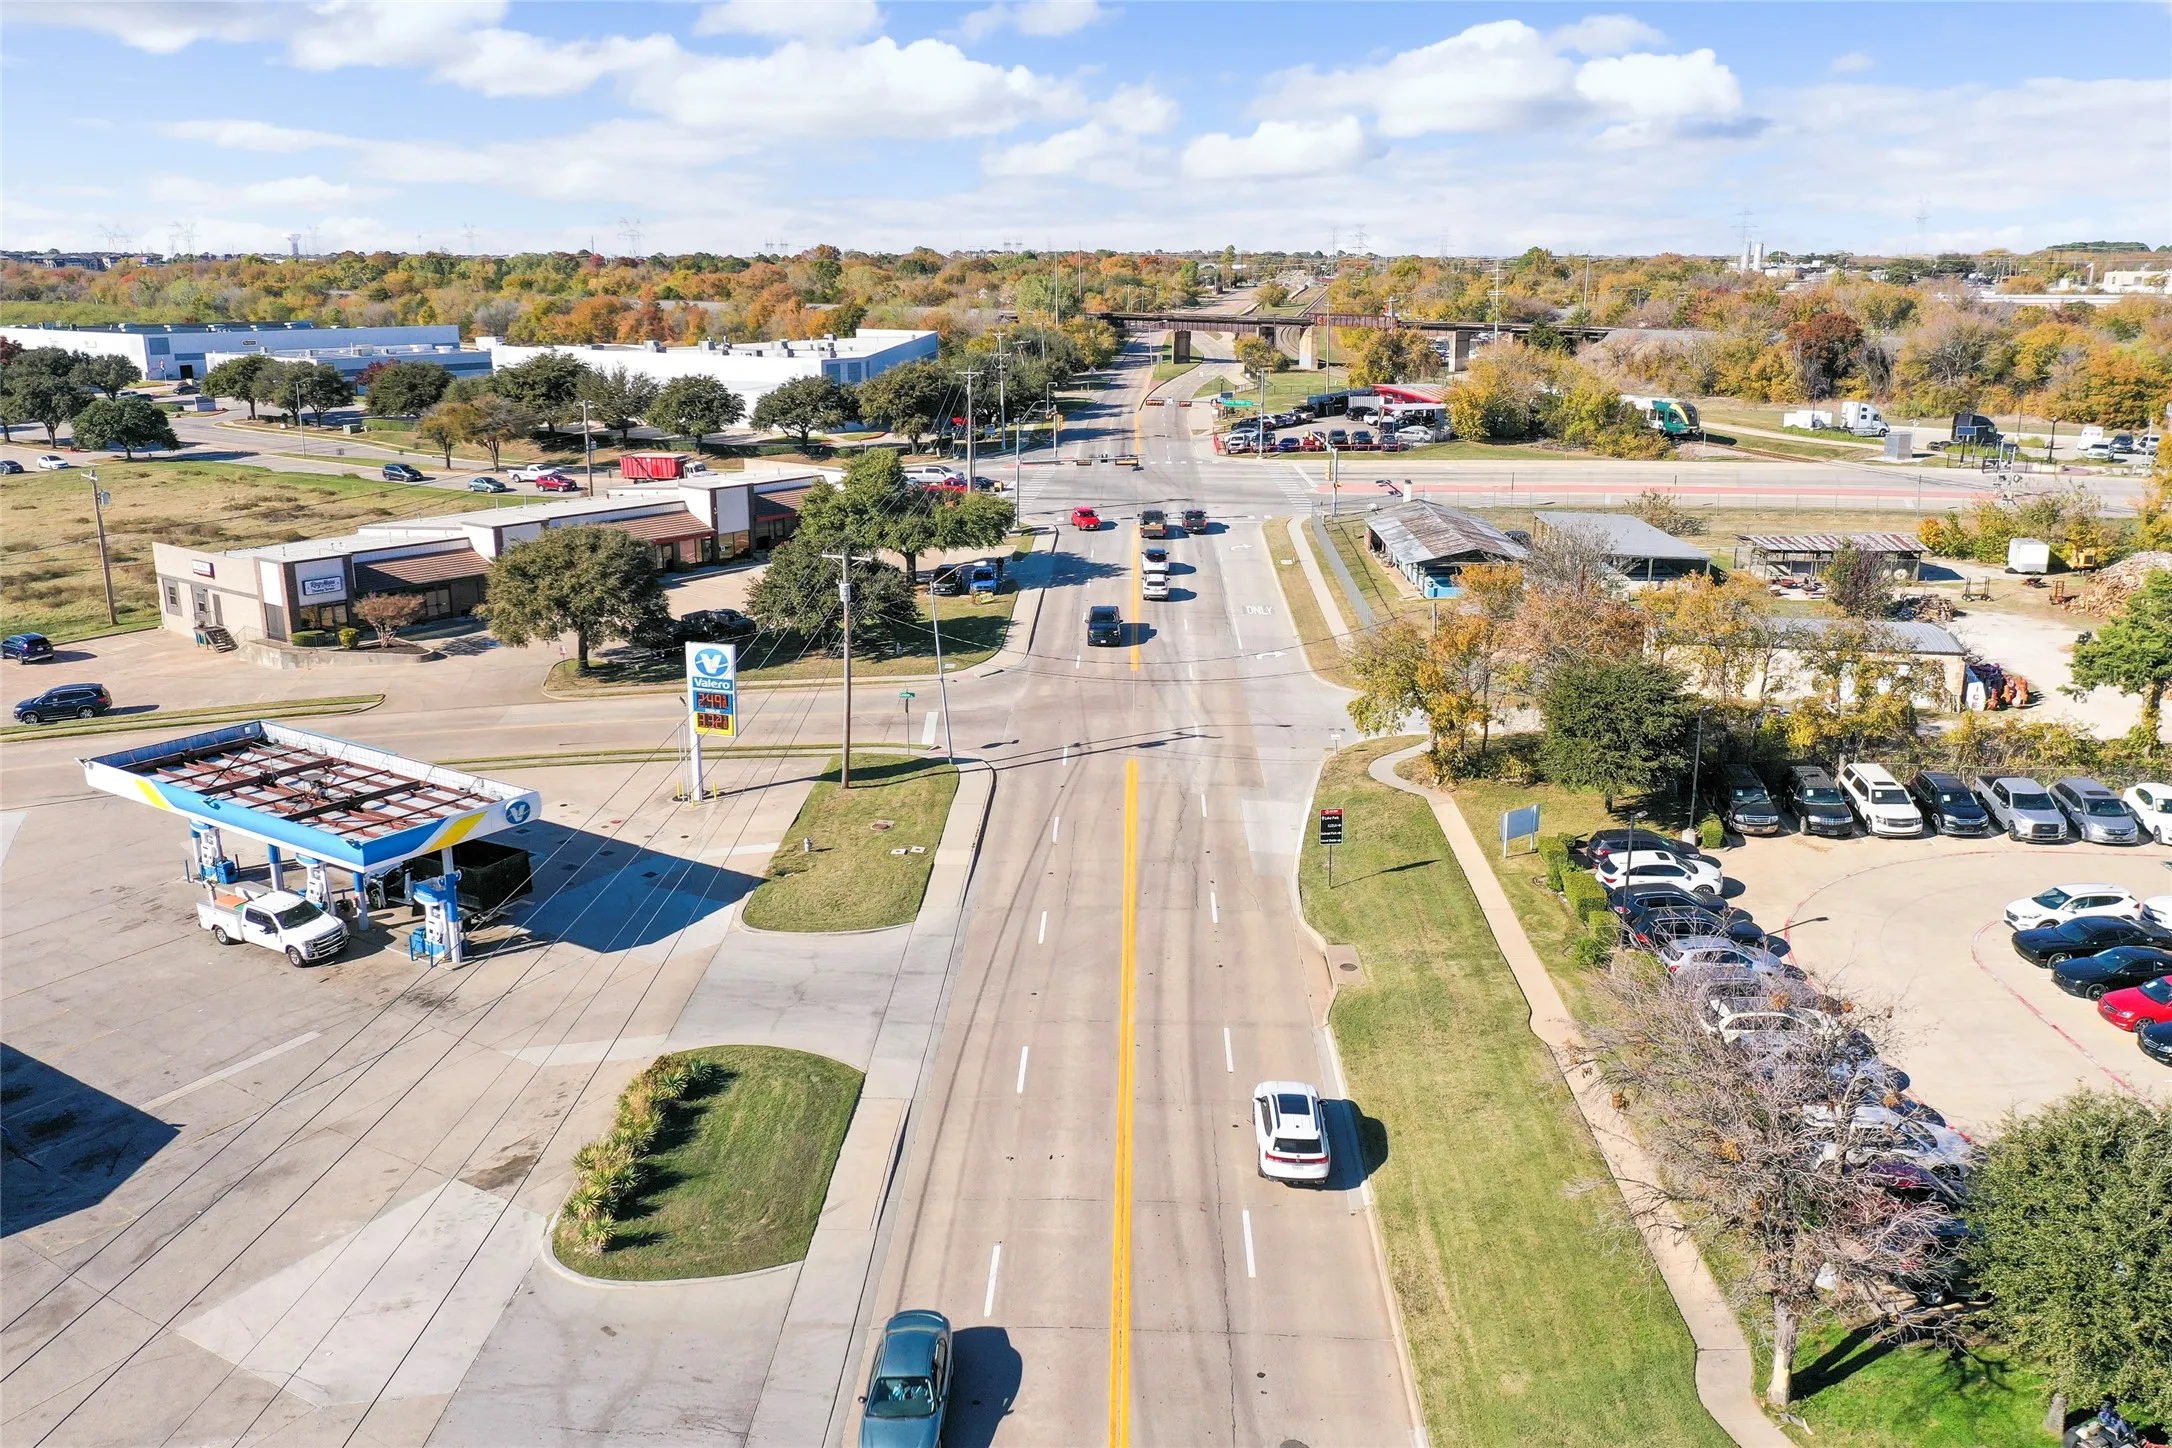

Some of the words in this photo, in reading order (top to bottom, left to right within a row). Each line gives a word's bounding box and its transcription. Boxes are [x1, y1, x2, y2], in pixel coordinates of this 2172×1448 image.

[1246, 605, 1273, 615] ONLY
[694, 677, 731, 690] Valero
[1971, 685, 1980, 709] ICE
